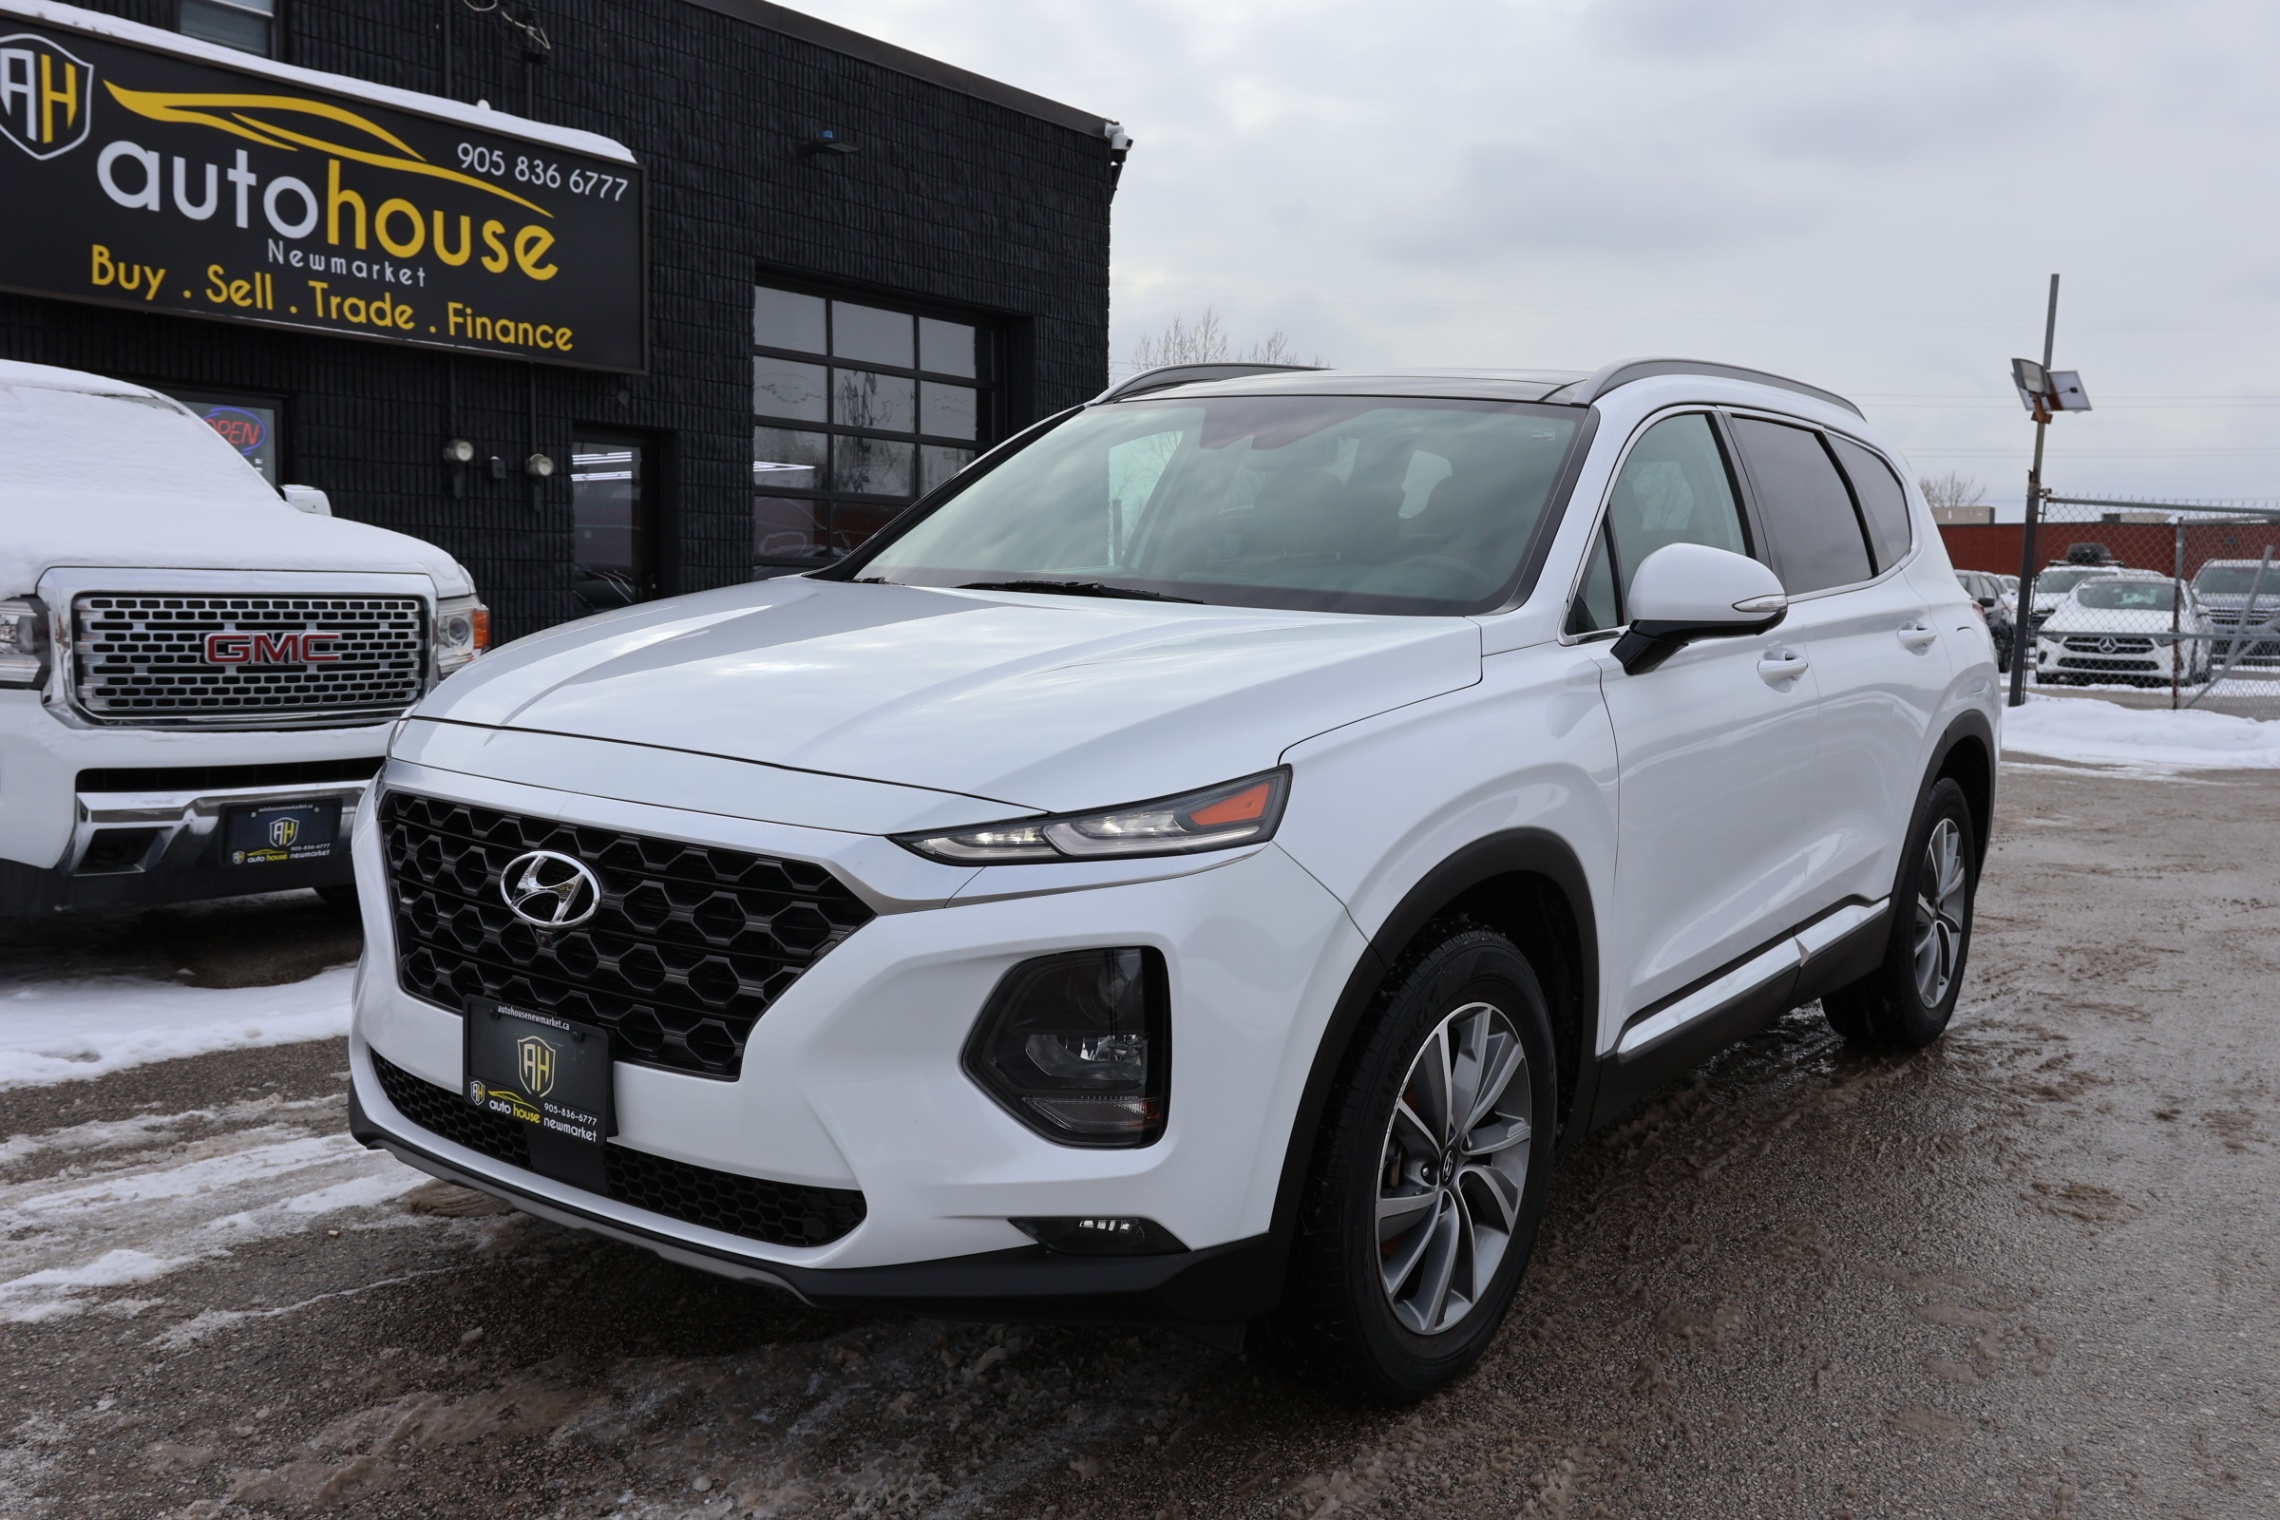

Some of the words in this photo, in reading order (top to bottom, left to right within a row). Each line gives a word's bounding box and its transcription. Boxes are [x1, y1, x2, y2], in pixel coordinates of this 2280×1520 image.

[457, 142, 506, 177] 905
[514, 154, 562, 190] 836
[569, 169, 629, 202] 6777
[267, 238, 427, 288] Newmarket
[92, 244, 166, 300] Buy
[206, 264, 274, 311] Sell
[309, 280, 416, 331] Trade
[448, 301, 574, 352] Finance
[204, 632, 341, 666] GMC
[273, 821, 295, 846] AH
[266, 853, 288, 861] house
[290, 849, 331, 859] newmarket
[497, 1005, 570, 1031] autohousenewmarket.ca
[523, 1043, 550, 1092] AH
[489, 1099, 511, 1115] auto
[513, 1103, 541, 1124] house
[544, 1103, 598, 1127] 905-836-6777
[543, 1116, 598, 1143] newmarket
